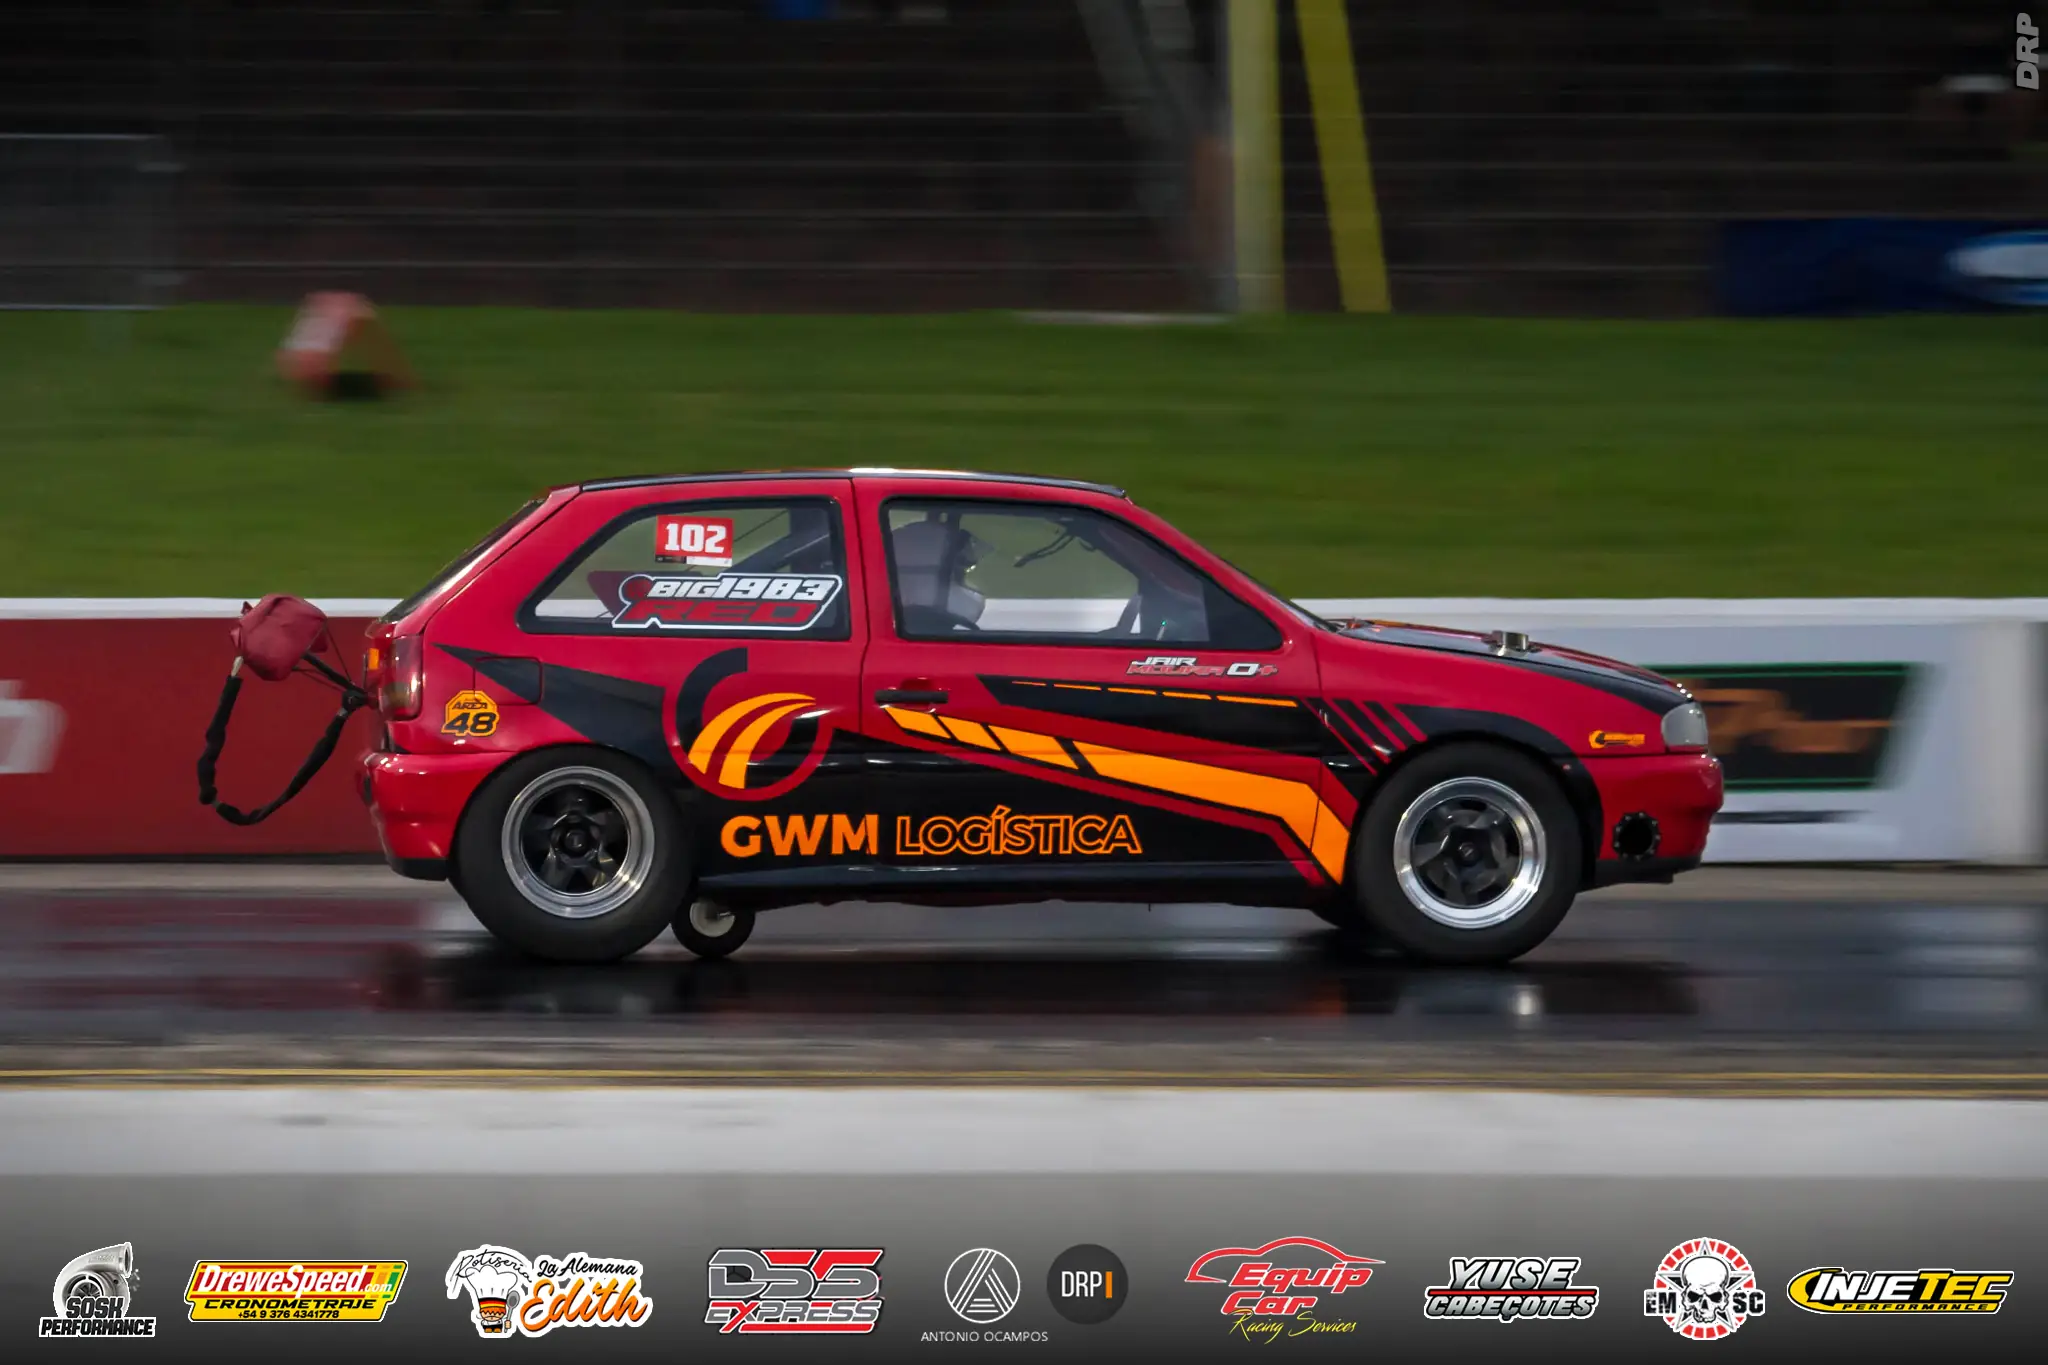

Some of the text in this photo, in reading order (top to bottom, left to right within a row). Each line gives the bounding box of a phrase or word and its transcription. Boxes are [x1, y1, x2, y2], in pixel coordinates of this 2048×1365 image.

[665, 523, 726, 553] 102
[623, 602, 817, 624] RED
[1131, 656, 1196, 666] JAIR
[444, 712, 496, 734] 48
[720, 804, 1142, 857] GWM LOGÍSTICA
